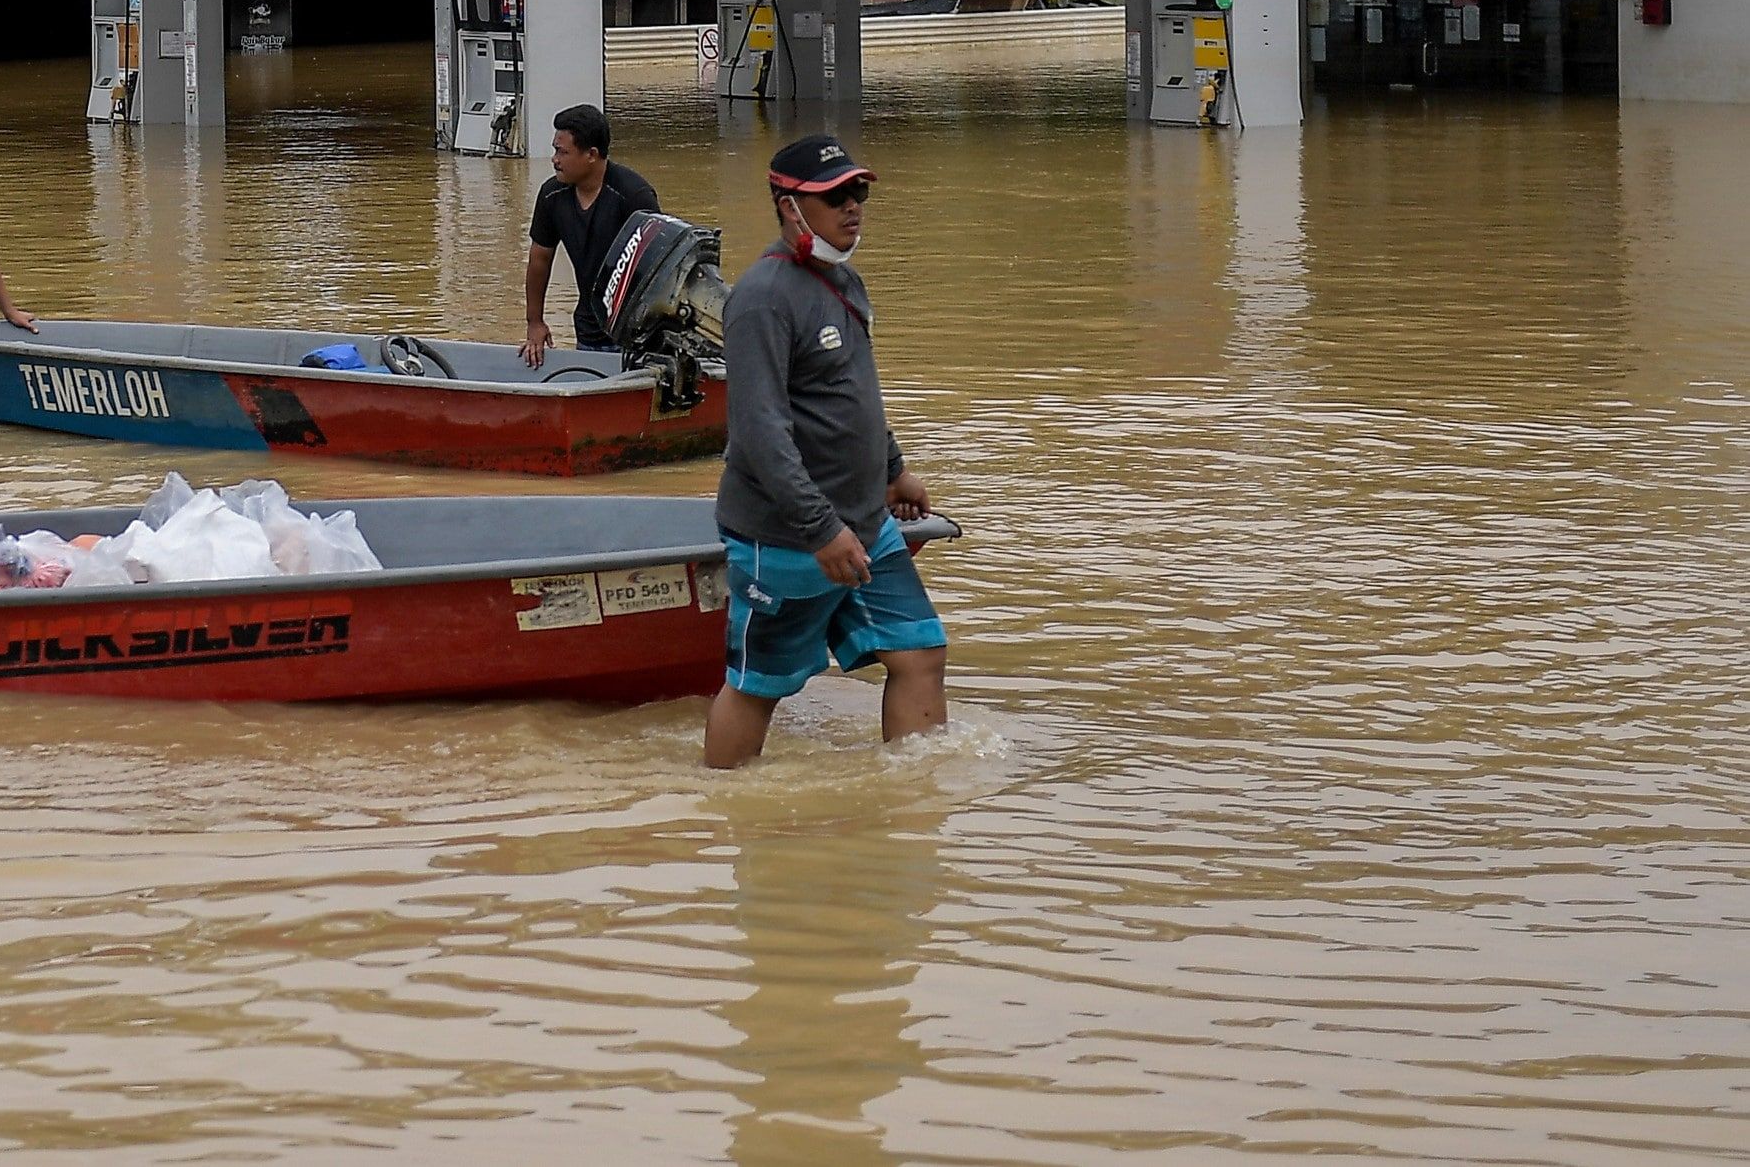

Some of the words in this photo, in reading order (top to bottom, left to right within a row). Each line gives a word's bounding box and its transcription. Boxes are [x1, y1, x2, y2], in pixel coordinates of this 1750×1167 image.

[602, 226, 643, 305] MERCURY
[18, 363, 171, 418] TEMERLOH
[641, 582, 670, 598] 549
[674, 580, 684, 592] T
